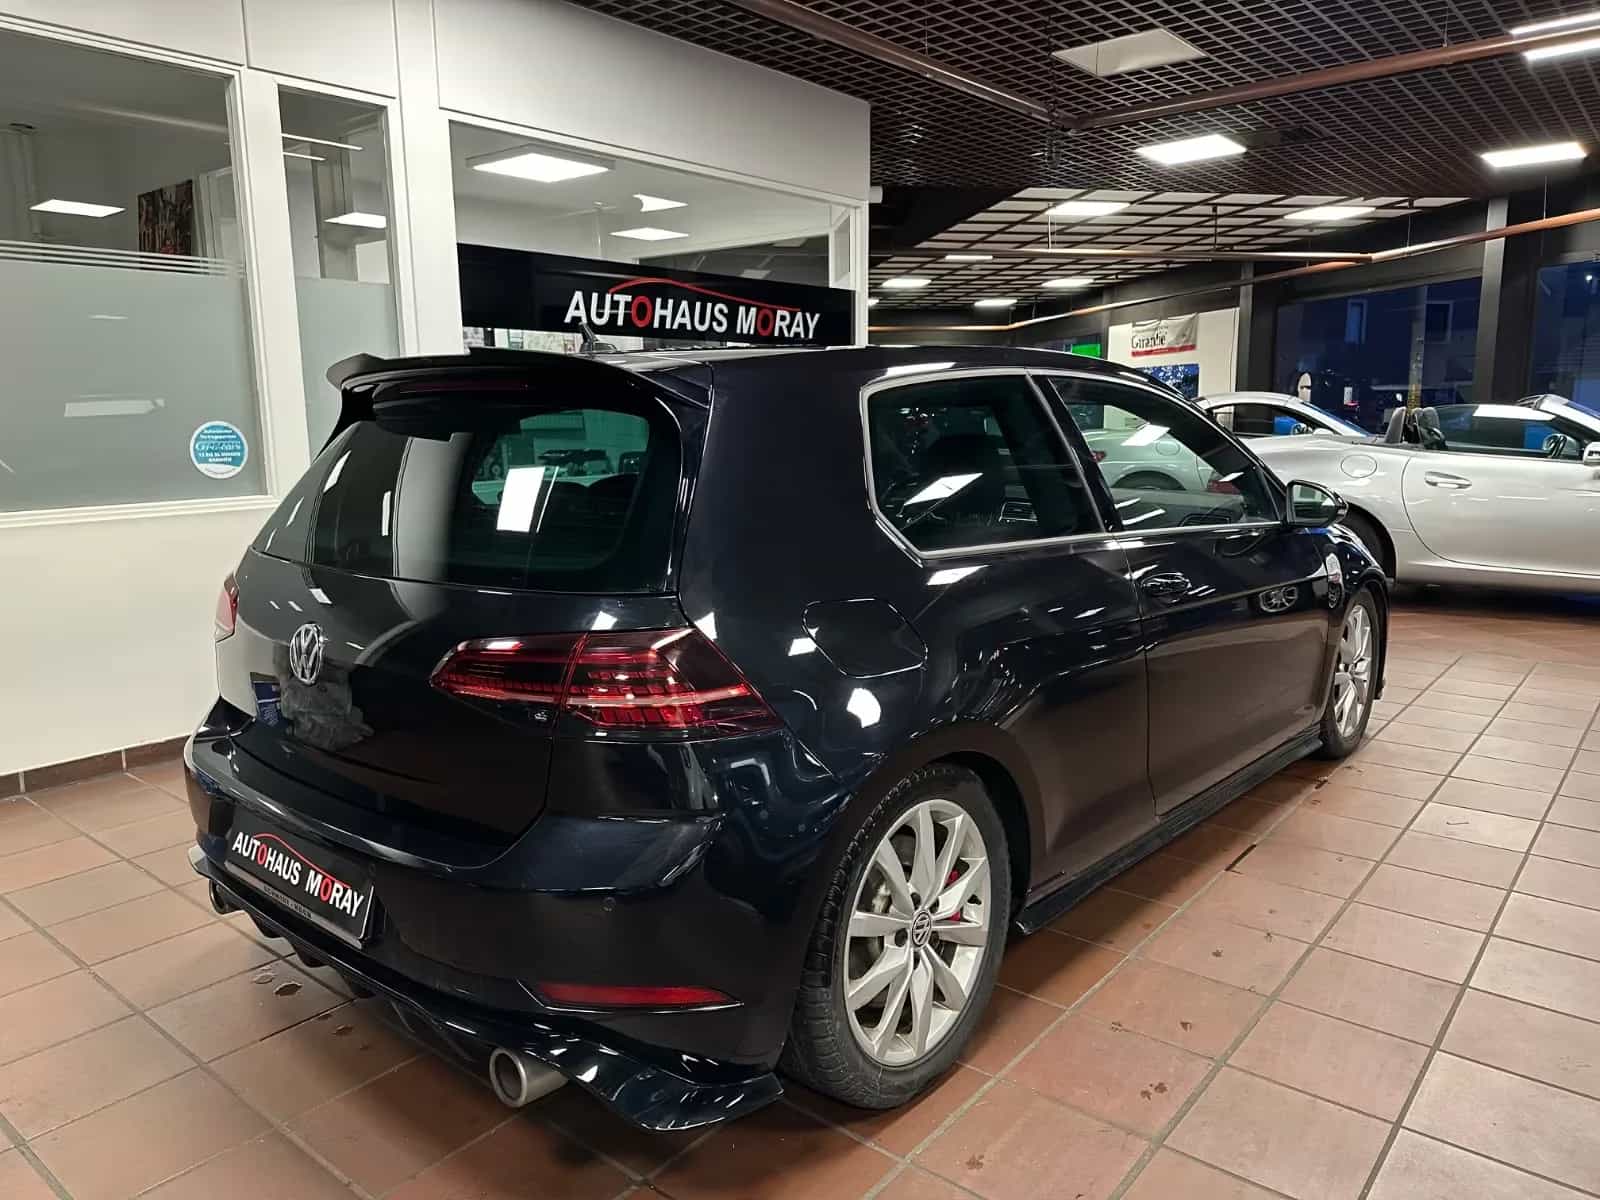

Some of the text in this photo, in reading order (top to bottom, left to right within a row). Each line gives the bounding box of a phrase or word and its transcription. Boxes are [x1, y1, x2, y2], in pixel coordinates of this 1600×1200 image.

[563, 290, 821, 340] AUTOHAUS MORAY
[231, 831, 302, 886] AUTOHAUS
[305, 869, 365, 918] MORAY
